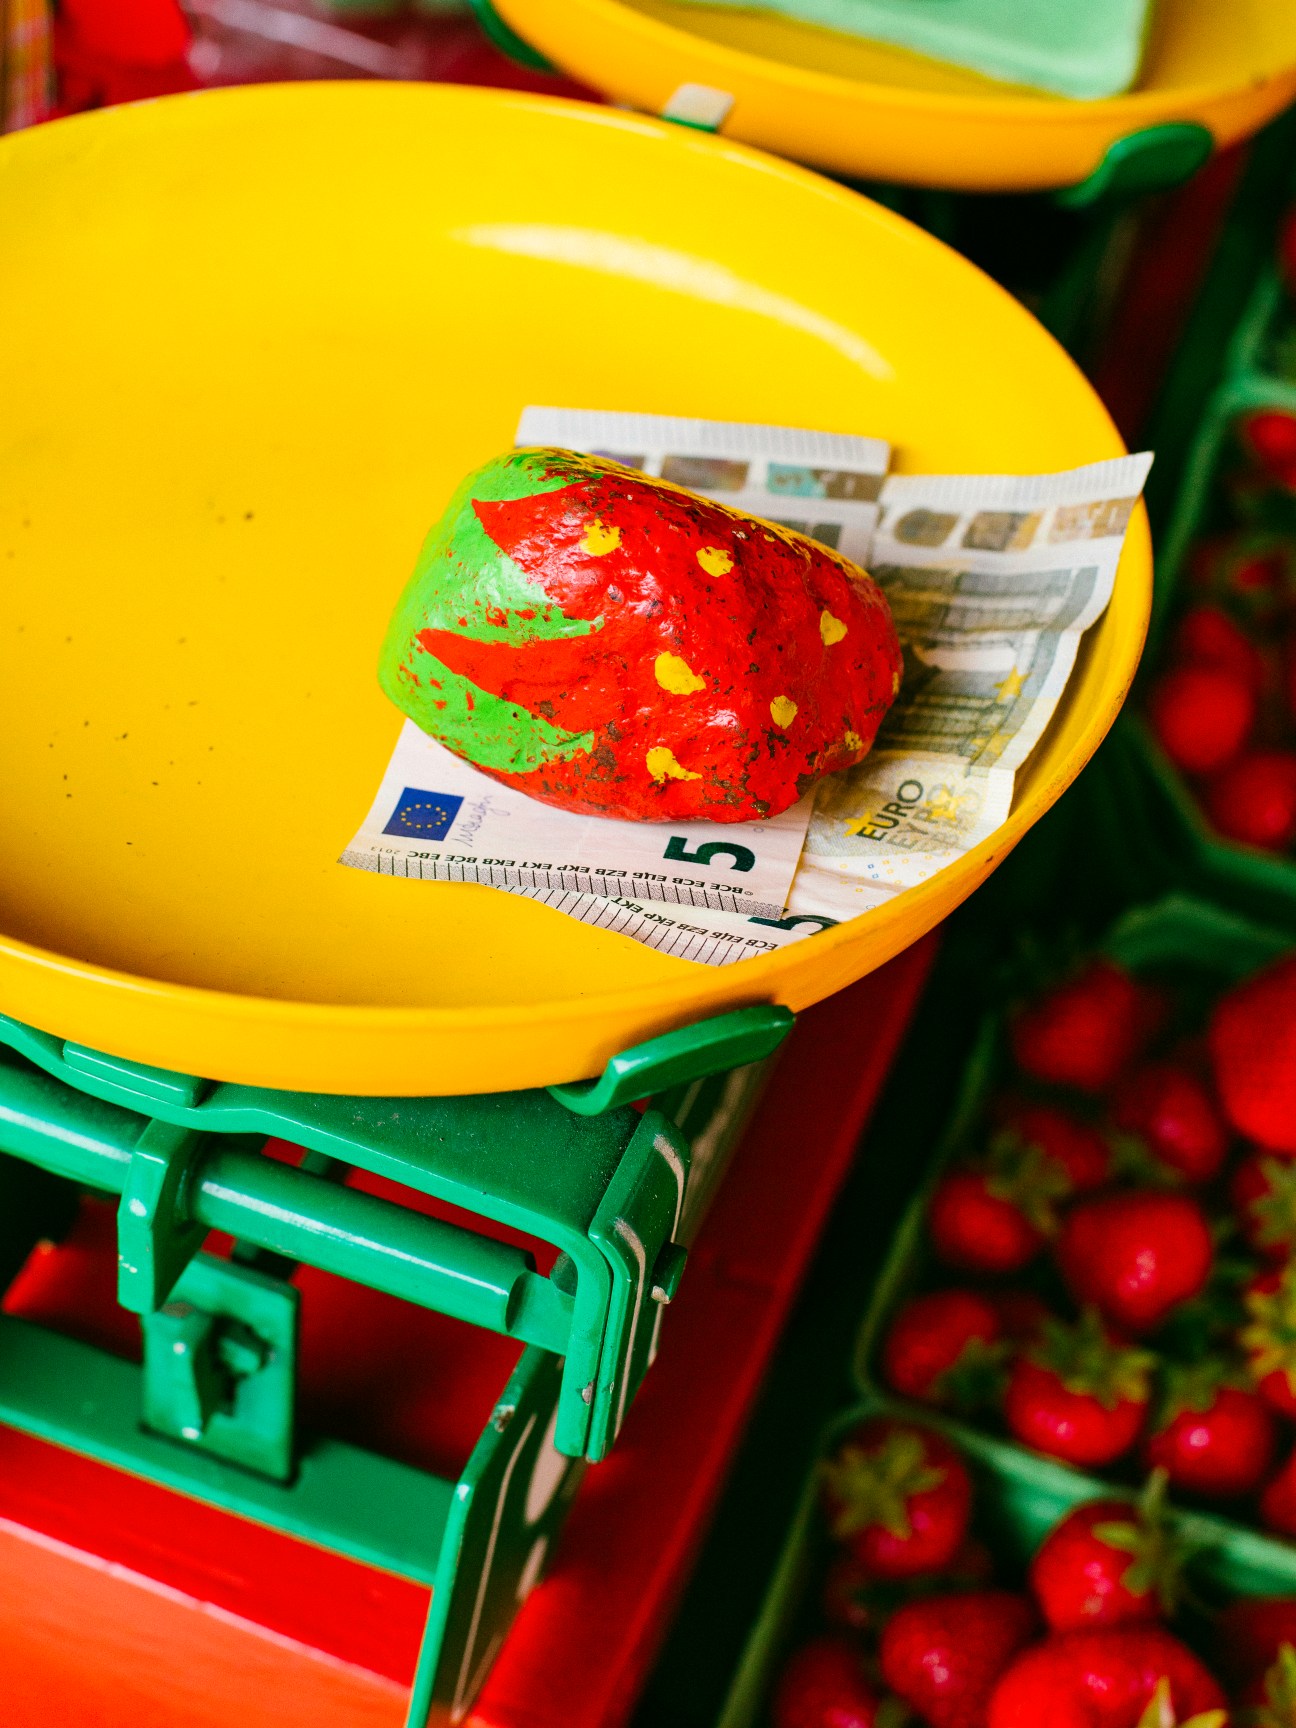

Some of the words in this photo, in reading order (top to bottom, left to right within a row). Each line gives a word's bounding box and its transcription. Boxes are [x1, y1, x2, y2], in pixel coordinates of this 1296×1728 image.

[856, 779, 924, 841] EURO
[370, 846, 401, 855] 2013
[407, 850, 441, 861] EBC
[663, 836, 755, 872] 5
[483, 858, 516, 867] EKB
[557, 865, 590, 874] EKP
[595, 868, 627, 877] EZB
[672, 877, 705, 888] ECB
[644, 913, 676, 926] EKP
[676, 922, 712, 936] EZB
[745, 939, 779, 951] ECB
